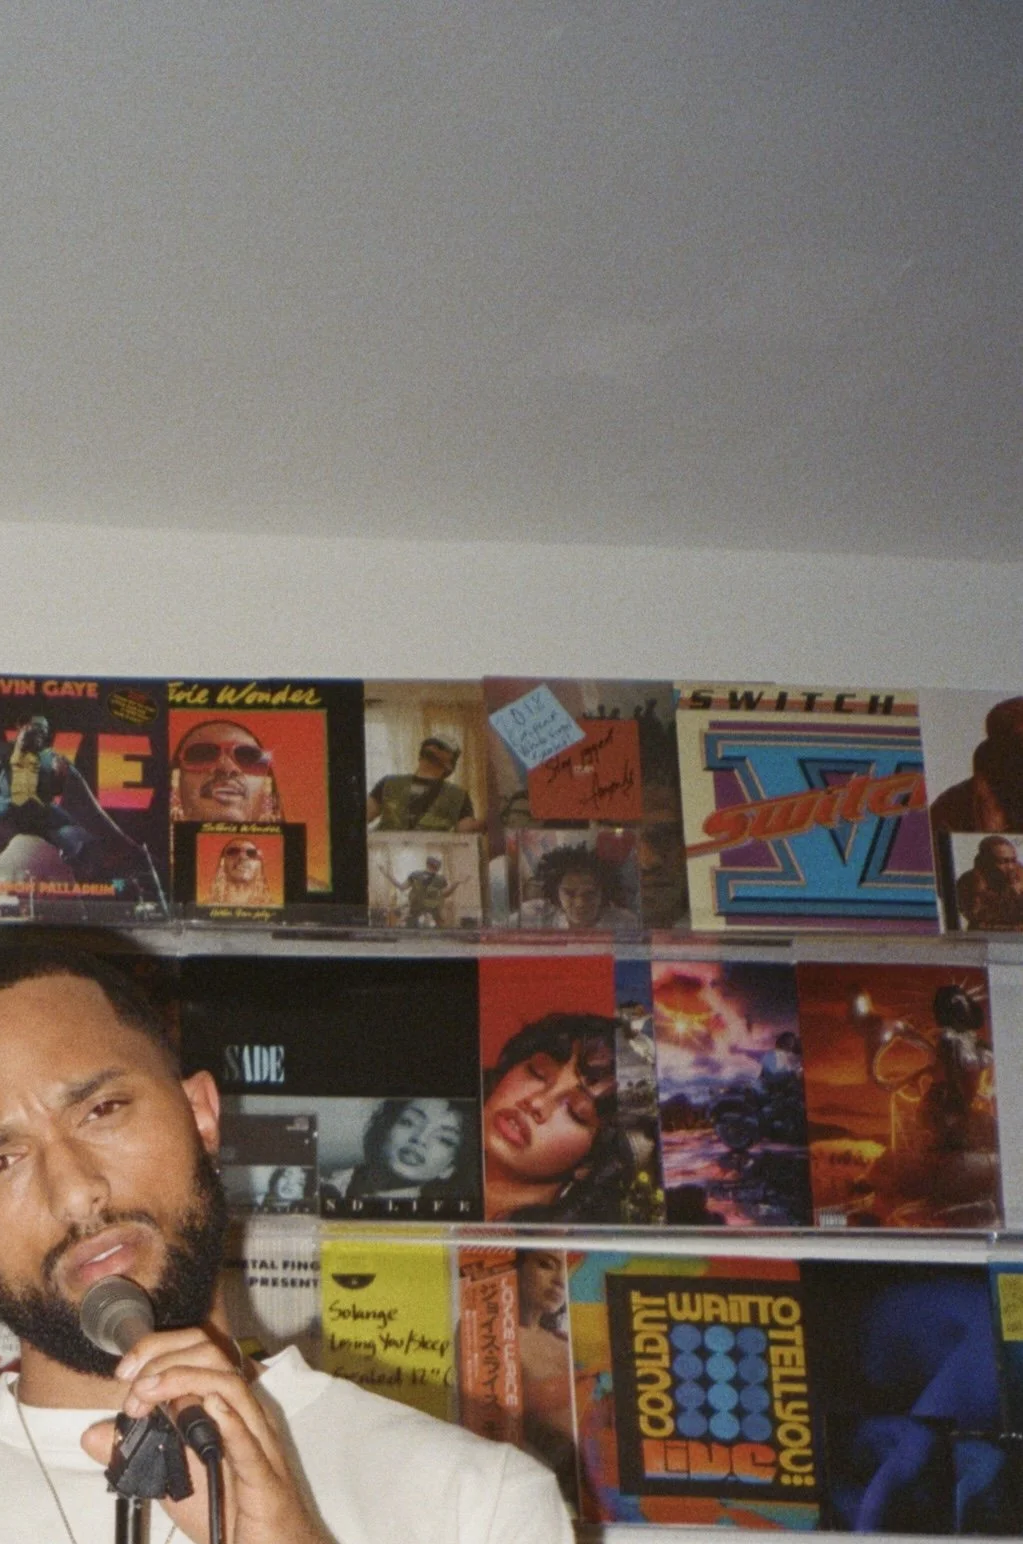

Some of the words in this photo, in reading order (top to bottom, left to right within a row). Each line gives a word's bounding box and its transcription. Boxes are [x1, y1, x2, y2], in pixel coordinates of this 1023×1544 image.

[42, 681, 98, 699] GAYE
[216, 681, 322, 705] Wonder
[688, 689, 895, 716] SWITCH
[225, 1045, 285, 1083] SADE
